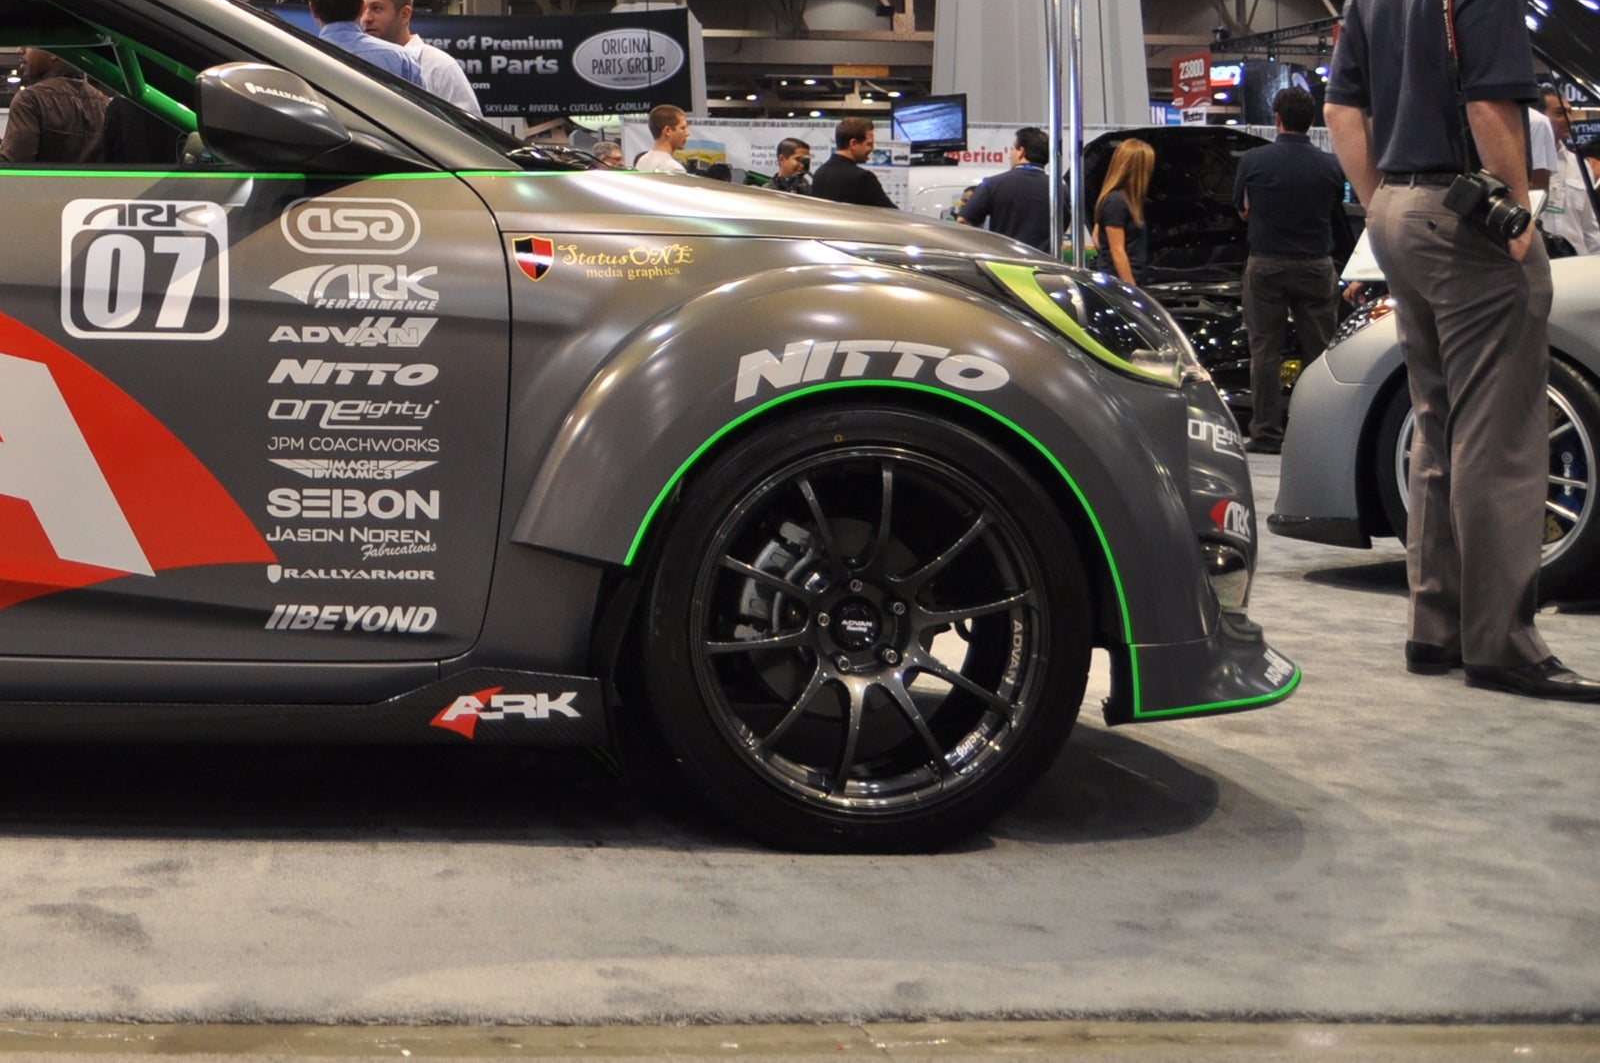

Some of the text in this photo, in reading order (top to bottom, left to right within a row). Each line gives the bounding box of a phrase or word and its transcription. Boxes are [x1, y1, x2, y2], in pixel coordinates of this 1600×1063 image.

[456, 35, 476, 50] of
[481, 35, 564, 51] Premium
[601, 37, 654, 56] ORIGINAL
[490, 55, 559, 75] Parts
[591, 58, 624, 75] PARTS
[484, 104, 519, 114] SKYLARK
[528, 104, 559, 113] RIVIERA
[568, 103, 604, 113] CUTLASS
[82, 203, 208, 228] ARK
[83, 233, 207, 329] 07
[586, 265, 682, 280] media graphics
[313, 264, 440, 301] ARK
[314, 298, 440, 311] PERFORMANCE
[268, 324, 422, 346] ADVAN
[267, 359, 440, 386] NITTO
[734, 339, 1011, 403] NITTO
[267, 436, 440, 453] JPM COACHWORKS
[329, 459, 378, 470] IMAGE
[313, 469, 393, 480] DYNAMICS
[266, 488, 440, 519] SEIBON
[360, 541, 438, 561] Fabrications
[283, 568, 436, 580] RALLYARMOR
[440, 691, 583, 722] ARK
